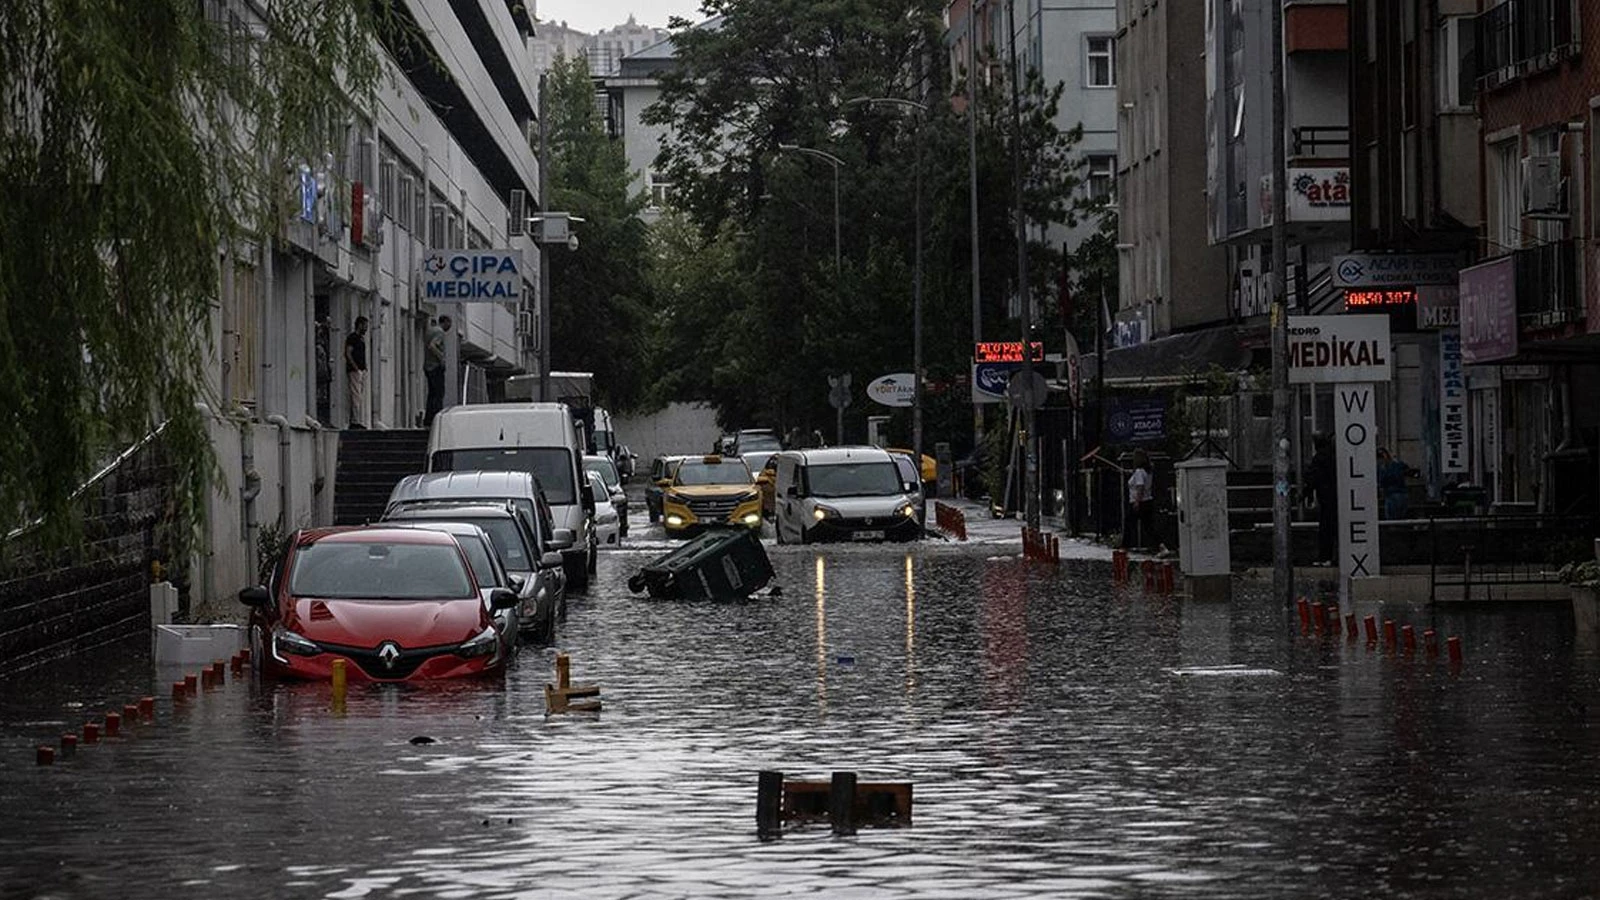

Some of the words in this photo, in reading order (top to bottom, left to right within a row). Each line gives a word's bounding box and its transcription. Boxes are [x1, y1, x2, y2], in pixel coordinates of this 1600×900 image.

[1308, 180, 1352, 201] ata
[449, 255, 518, 278] ÇIPA
[426, 277, 518, 298] MEDİKAL
[1341, 390, 1370, 577] WOLLEX
